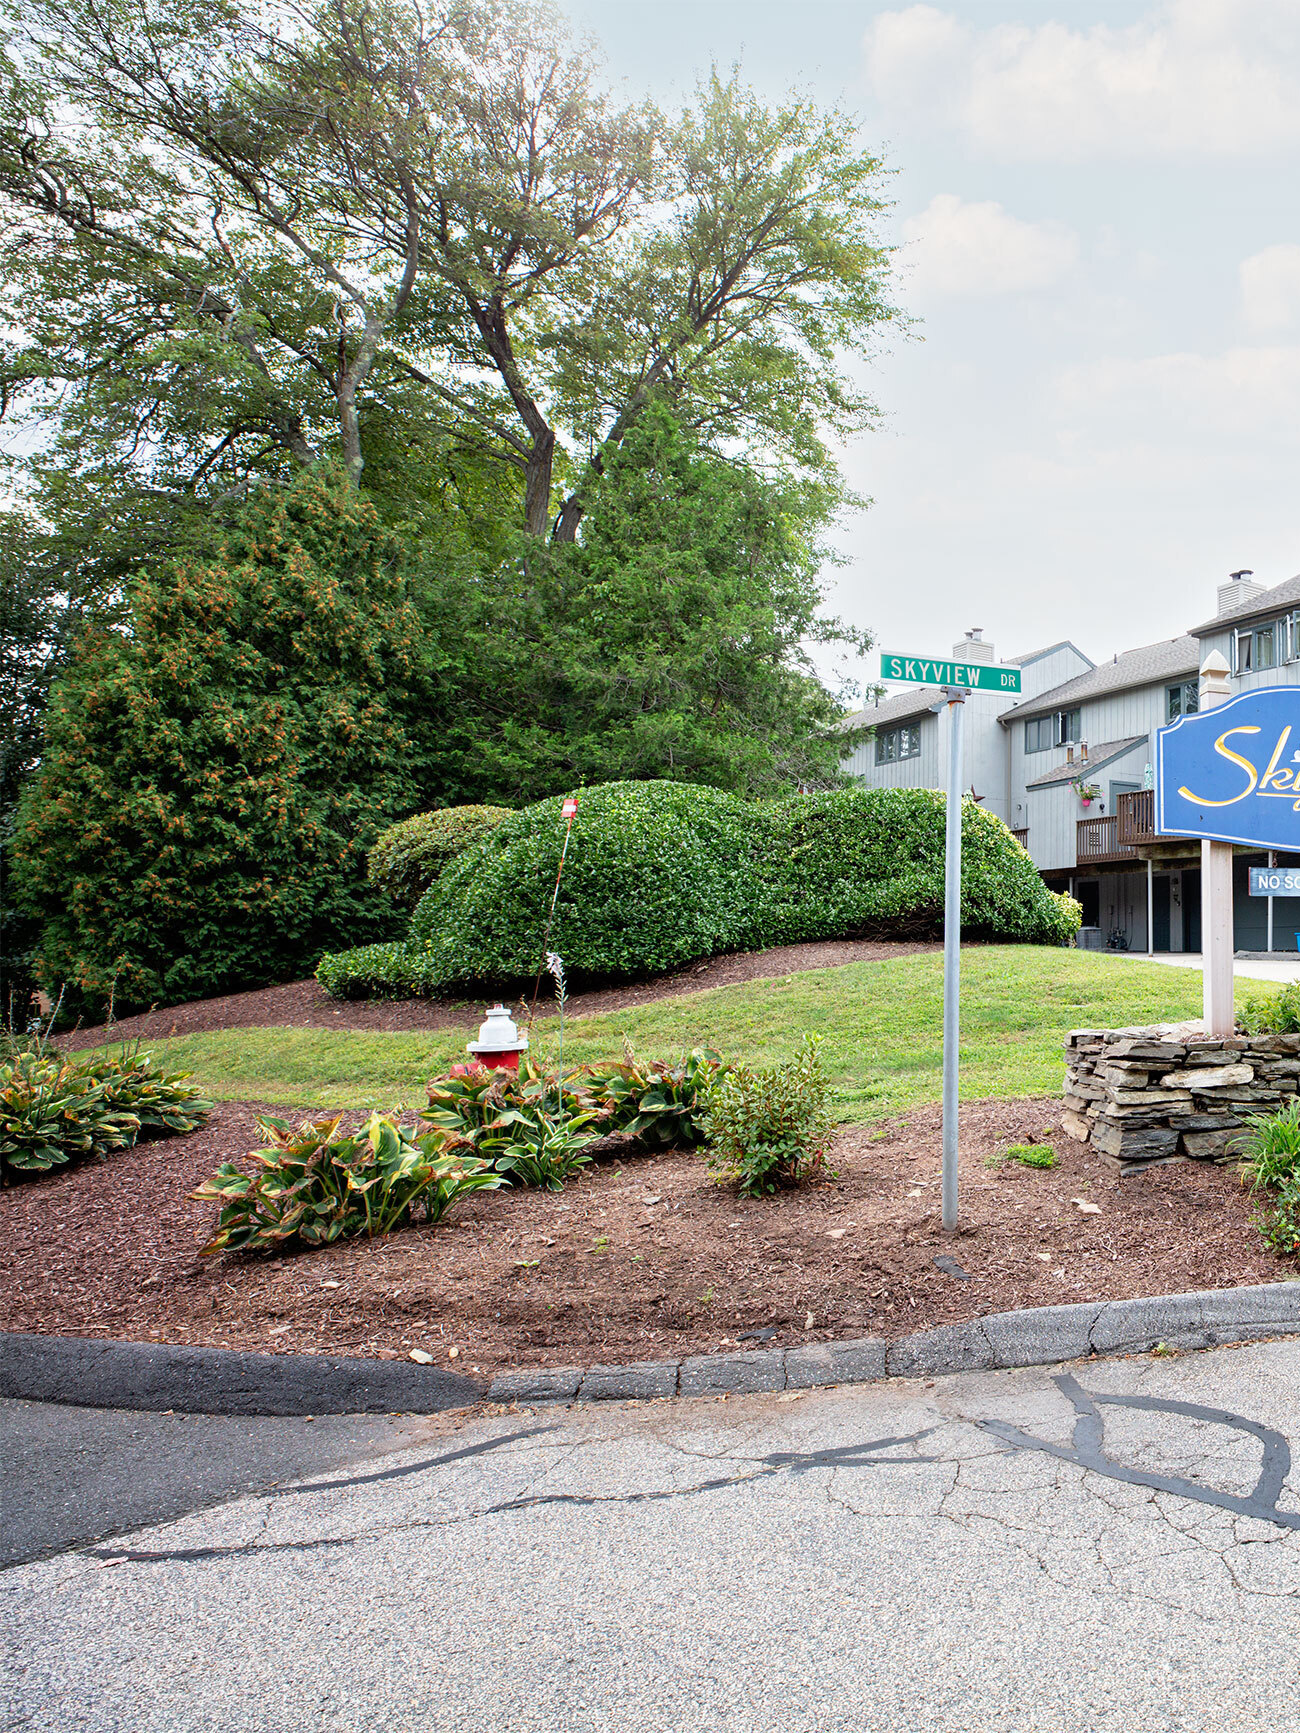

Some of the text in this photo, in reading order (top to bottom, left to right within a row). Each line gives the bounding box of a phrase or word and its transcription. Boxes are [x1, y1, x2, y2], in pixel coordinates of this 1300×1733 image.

[890, 658, 1016, 688] SKYVIEW DR
[1258, 875, 1281, 890] NO
